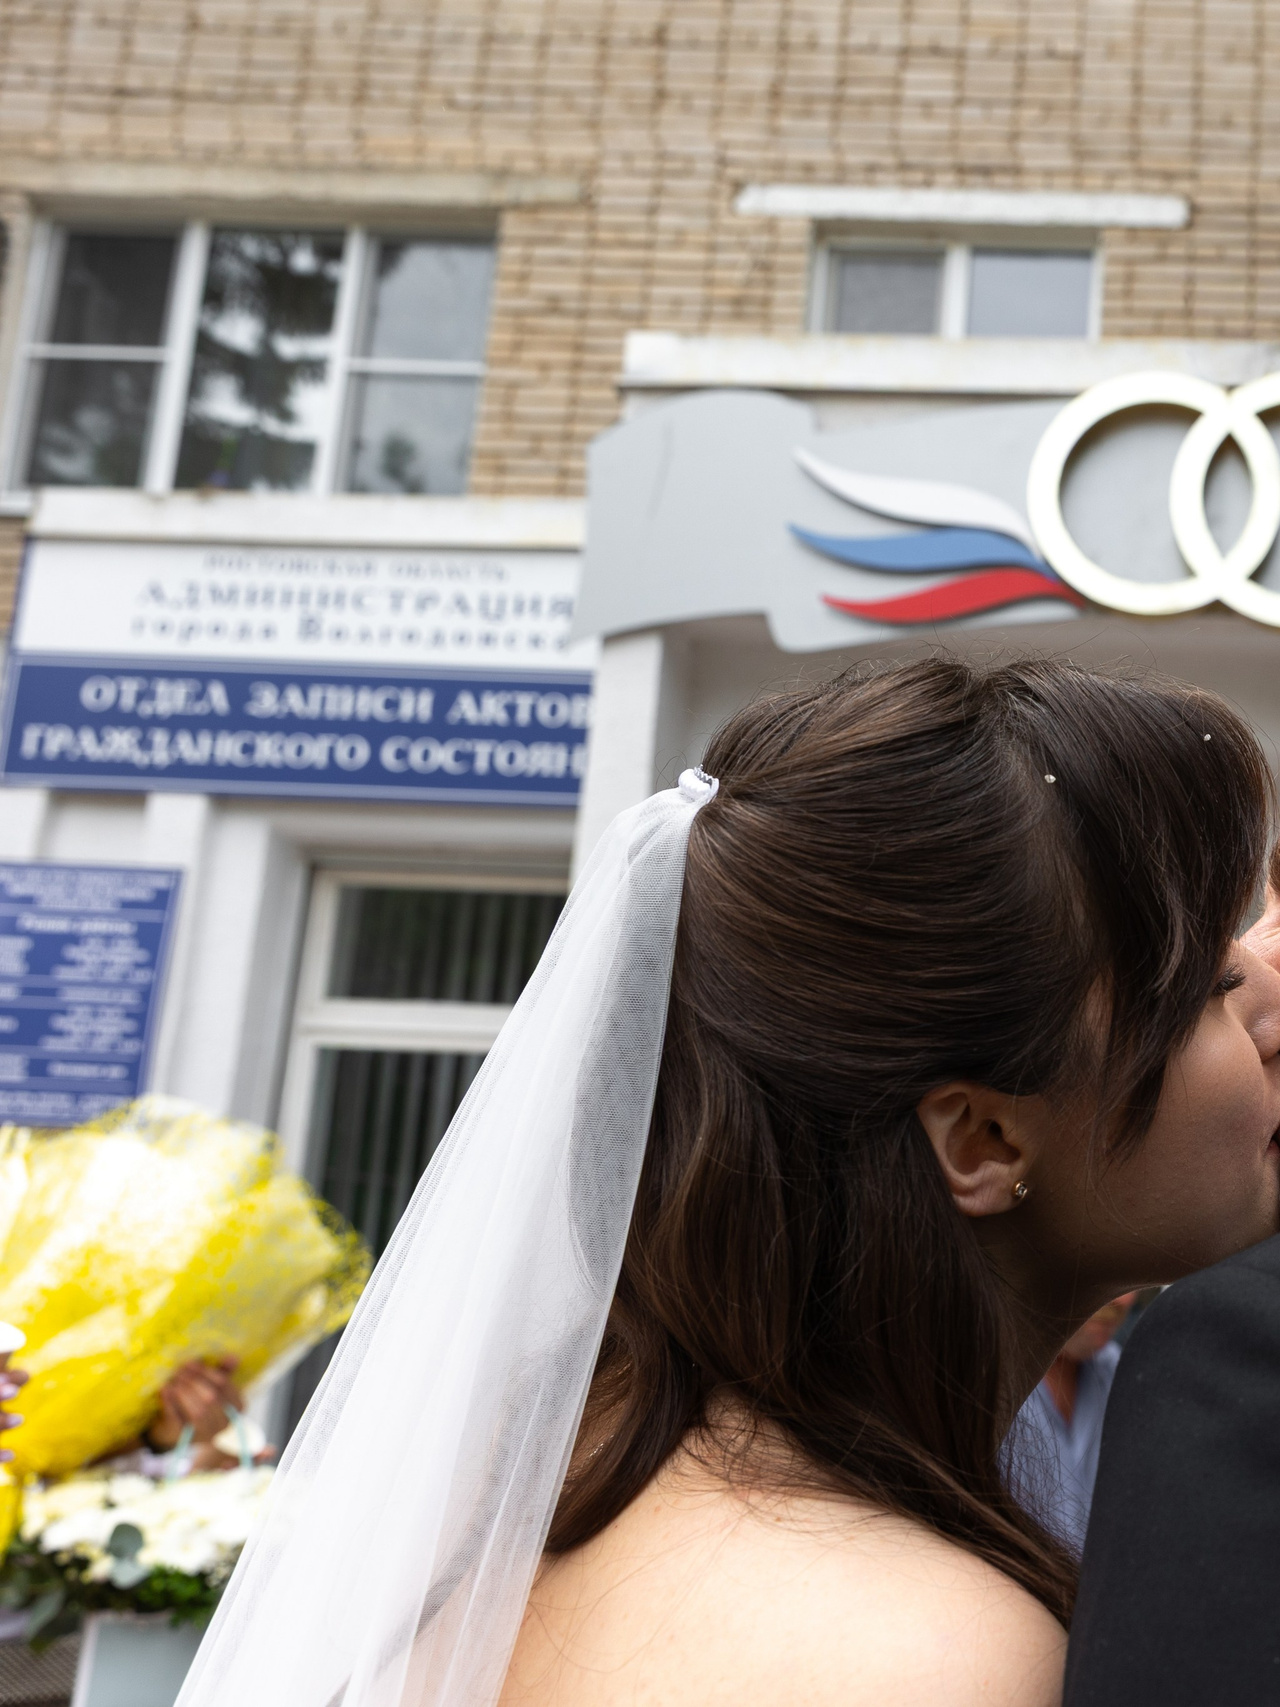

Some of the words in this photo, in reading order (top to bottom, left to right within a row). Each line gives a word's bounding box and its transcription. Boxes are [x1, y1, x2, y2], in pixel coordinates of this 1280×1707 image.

[137, 577, 574, 621] АДМИНИСТРАЦИЯ
[131, 613, 278, 645] города
[79, 674, 231, 720] ОТДЕЛ
[243, 680, 435, 723] ЗАПИСИ
[20, 721, 371, 771] ГРАЖДАНСКОГО
[379, 735, 589, 778] СОСТОЯН
